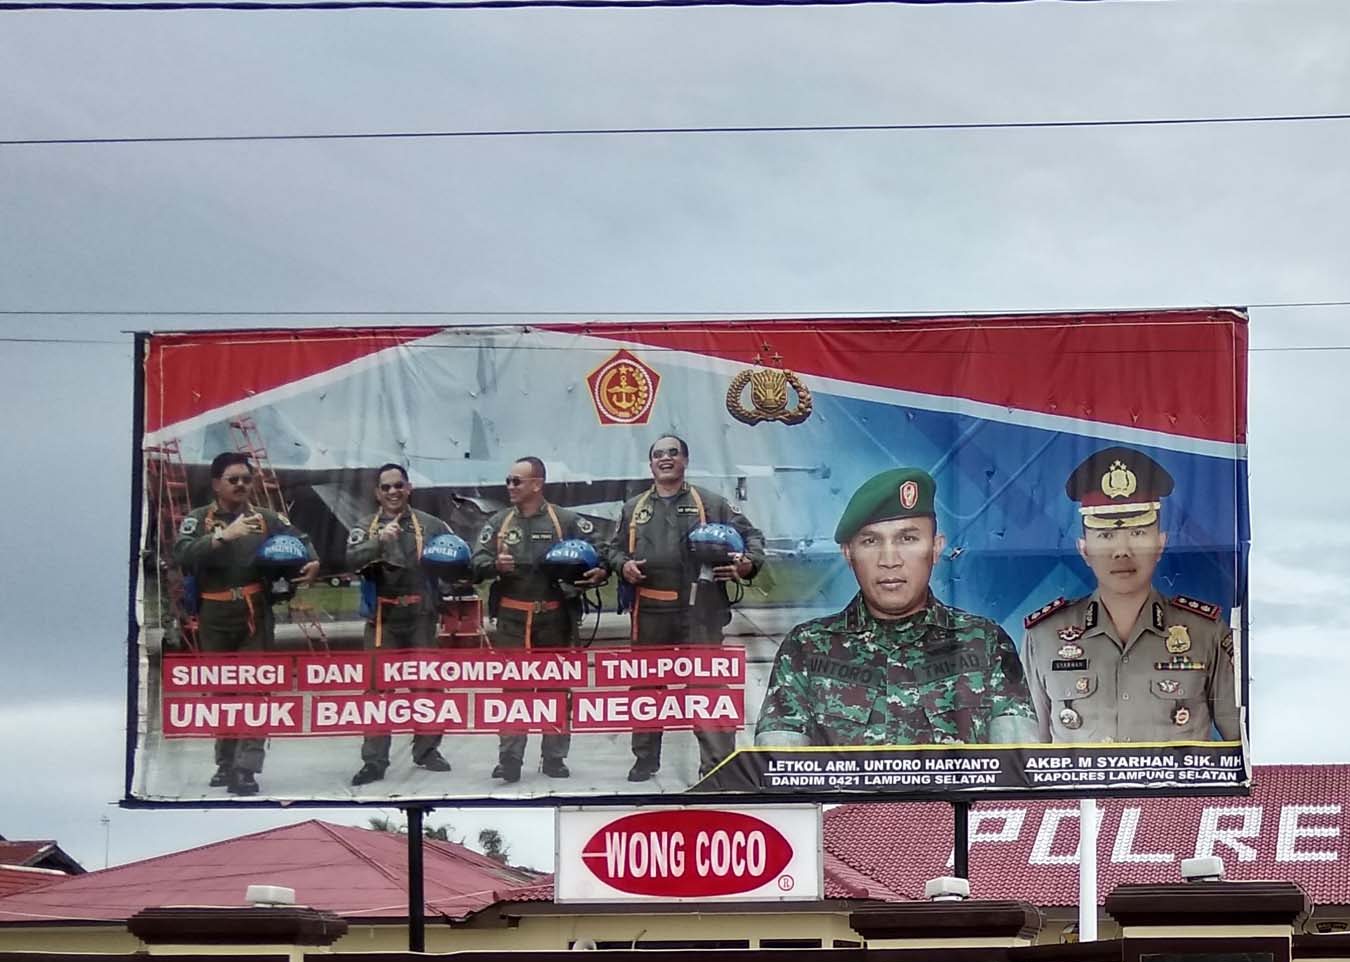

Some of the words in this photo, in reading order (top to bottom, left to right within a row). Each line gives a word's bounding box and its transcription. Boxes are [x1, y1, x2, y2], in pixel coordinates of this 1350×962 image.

[172, 664, 284, 686] SINERGI
[307, 663, 363, 684] DAN
[383, 660, 582, 682] KEKOMPAKAN
[602, 657, 739, 680] TNI-POLRI
[170, 702, 295, 727] UNTUK
[316, 698, 462, 726] BANGSA
[484, 698, 557, 723] DAN
[578, 694, 739, 722] NEGARA
[768, 760, 822, 772] LETKOL
[826, 760, 860, 772] ARM.
[864, 759, 921, 772] UNTORO
[925, 758, 1000, 771] HARYANTO
[1026, 757, 1073, 769] AKBP.
[1078, 757, 1092, 768] M
[1097, 755, 1178, 769] SYARHAN,
[1183, 755, 1215, 767] SIK.
[771, 775, 825, 786] DANDIM
[828, 775, 860, 786] 0421
[865, 775, 931, 785] LAMPUNG
[934, 774, 996, 785] SELATAN
[1034, 771, 1105, 783] KAPOLRES
[1109, 770, 1176, 781] LAMPUNG
[1178, 770, 1237, 781] SELATAN
[605, 831, 685, 878] WONG
[695, 830, 766, 877] COCO
